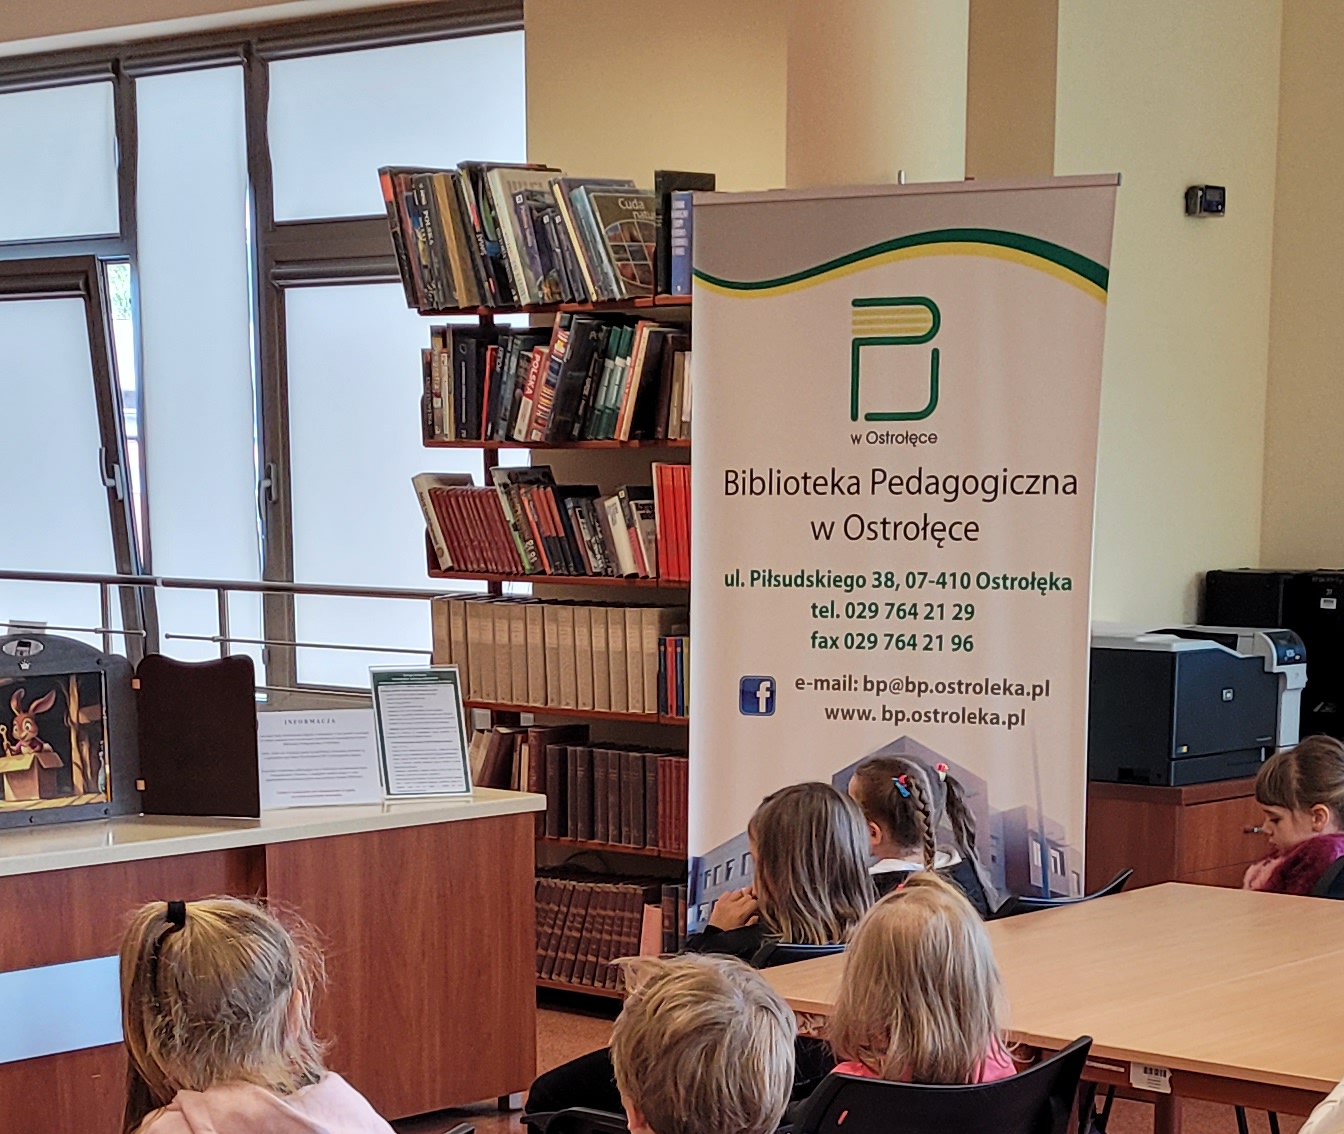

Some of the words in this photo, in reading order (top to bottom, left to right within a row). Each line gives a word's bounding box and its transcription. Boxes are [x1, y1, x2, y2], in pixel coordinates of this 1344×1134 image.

[618, 198, 645, 210] Cuda
[524, 353, 542, 395] POLSKA
[850, 432, 862, 444] w
[866, 430, 938, 447] Ostrołęce
[724, 467, 861, 496] Biblioteka
[870, 466, 1078, 503] Pedagogiczna
[810, 519, 835, 541] w
[843, 512, 980, 548] Ostrołęce
[724, 569, 745, 588] ul.
[750, 568, 867, 593] Piłsudskiego
[871, 571, 901, 592] 38,
[905, 571, 971, 590] 07-410
[975, 571, 1073, 596] Ostrołęka
[810, 600, 840, 620] tel.
[845, 602, 879, 620] 029
[884, 602, 918, 621] 764
[923, 603, 945, 621] 21
[951, 603, 975, 621] 29
[810, 631, 839, 650] fax
[844, 632, 878, 650] 029
[883, 633, 918, 651] 764
[922, 634, 944, 652] 21
[951, 634, 974, 652] 96
[794, 674, 858, 692] e-mail:
[862, 675, 1051, 701] bp@bp.ostroleka.pl
[824, 706, 876, 722] www.
[881, 705, 1026, 728] bp.ostroleka.pl
